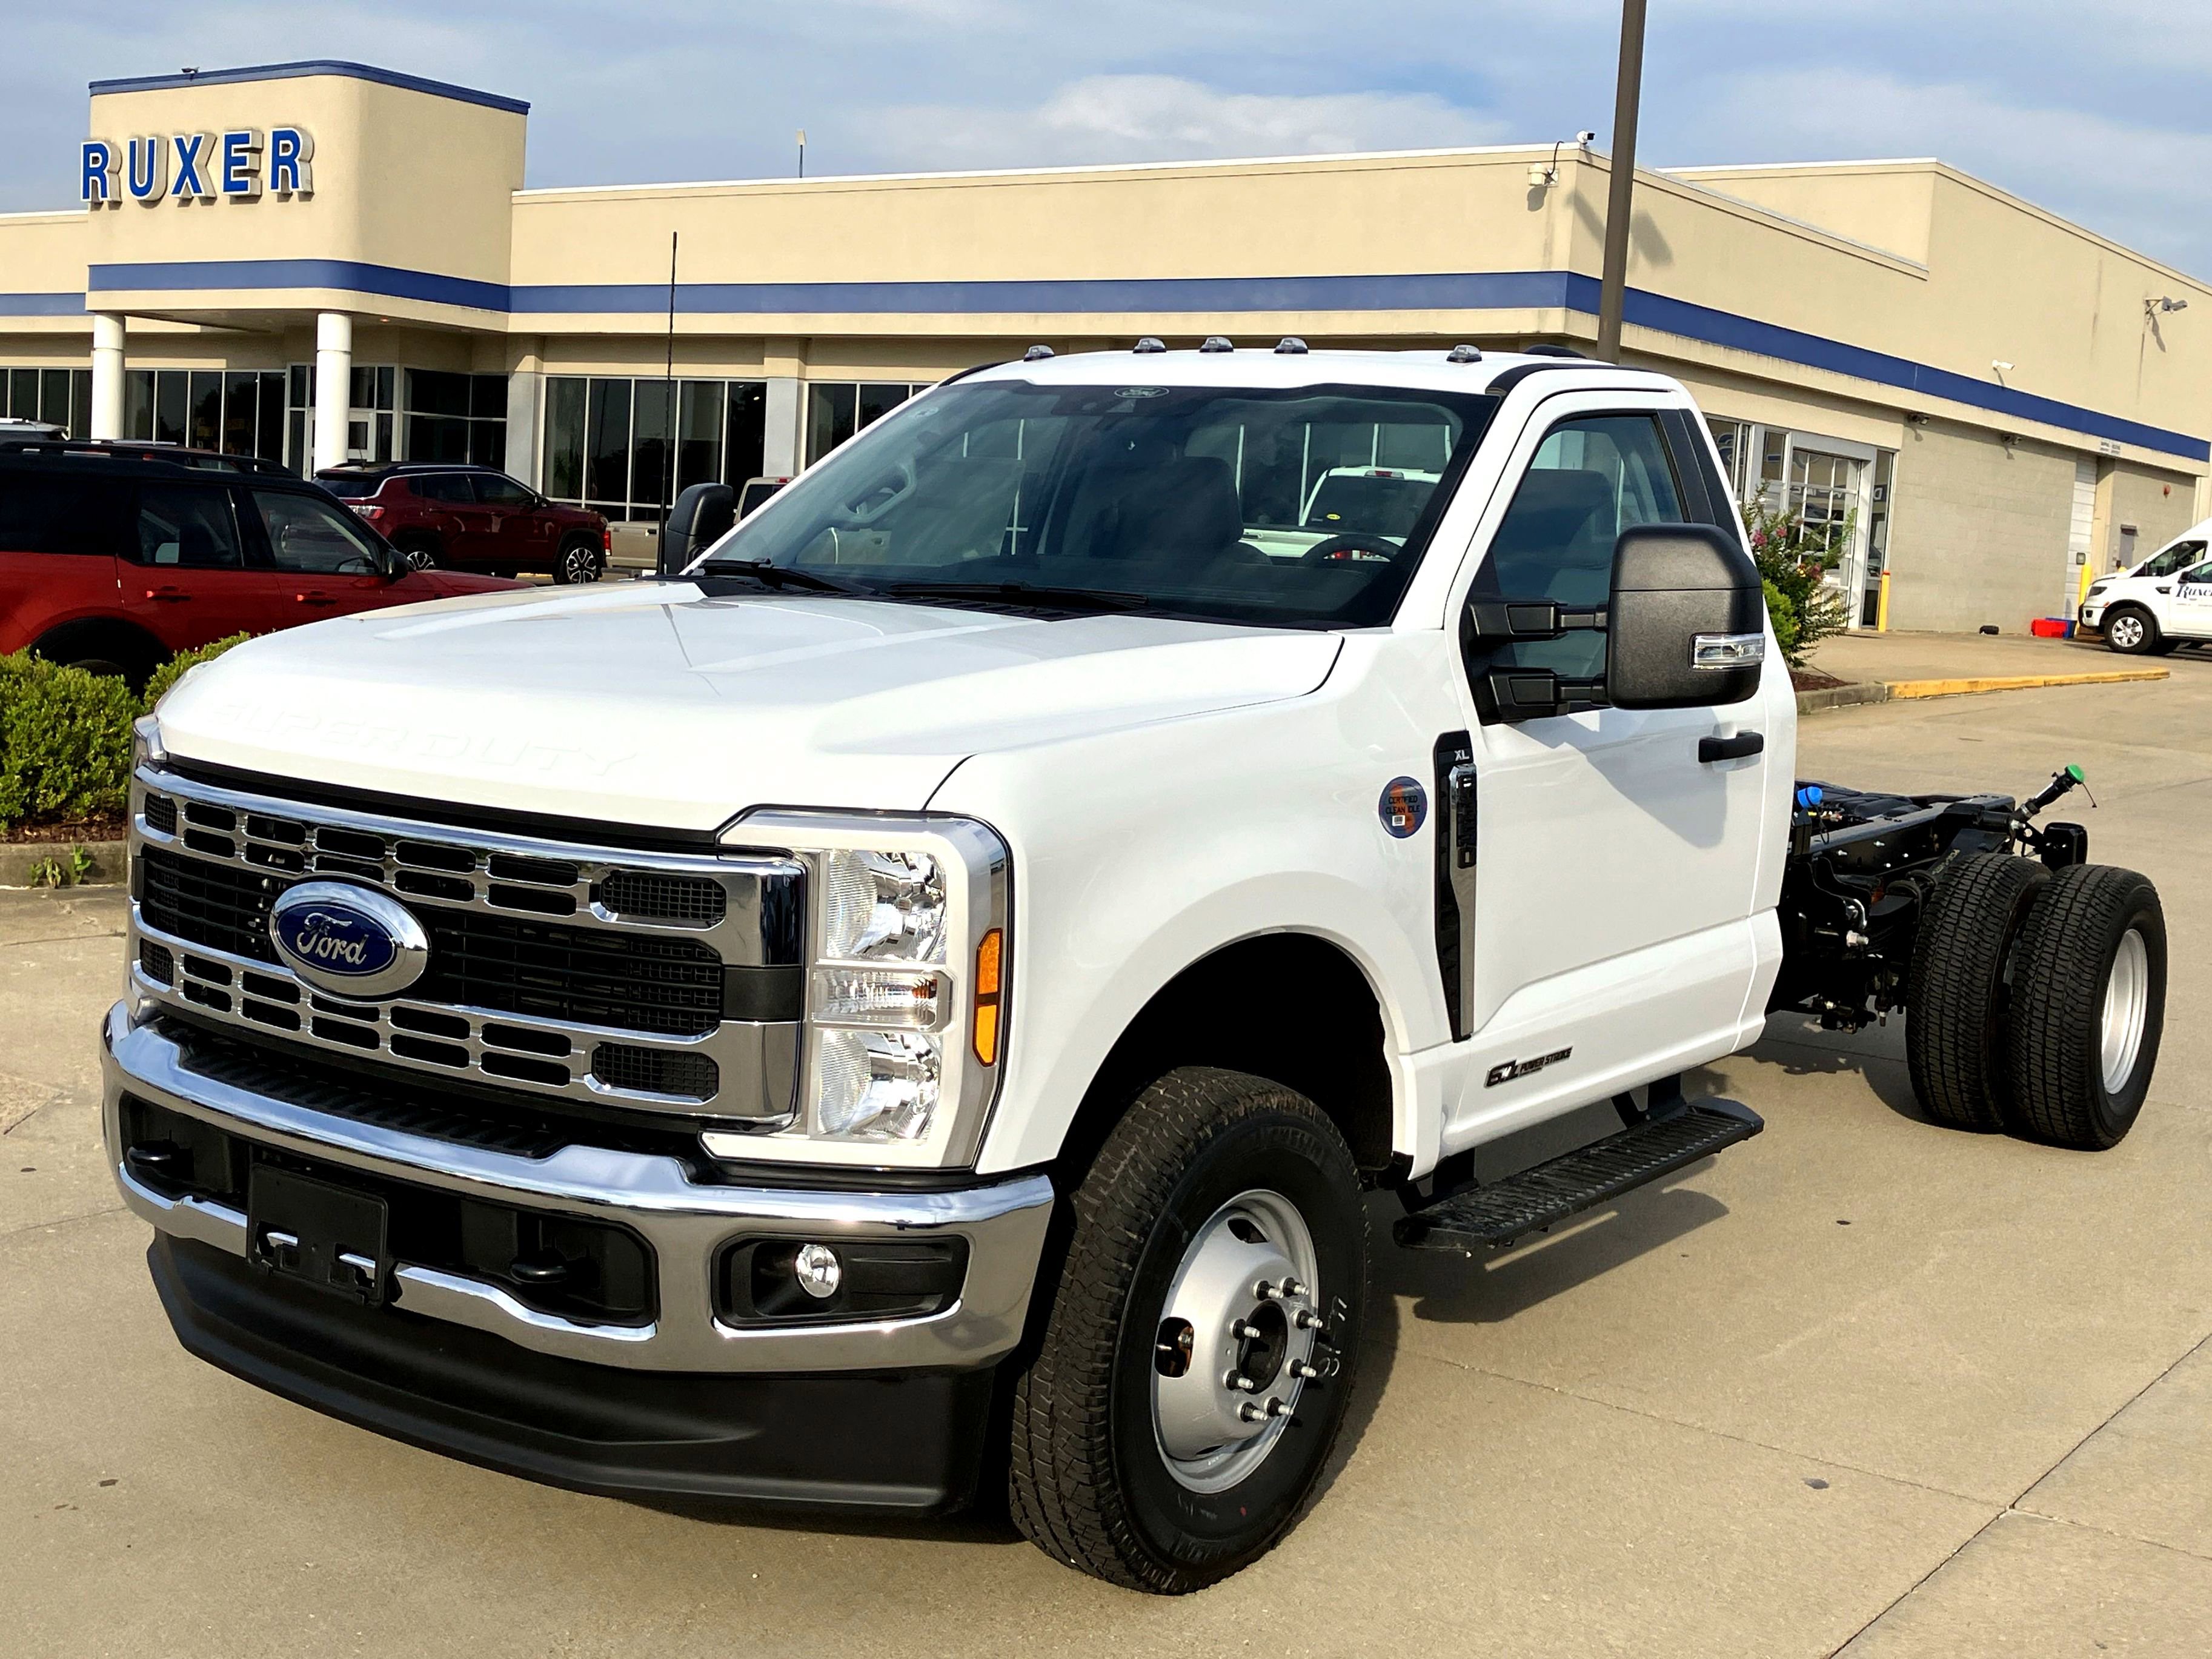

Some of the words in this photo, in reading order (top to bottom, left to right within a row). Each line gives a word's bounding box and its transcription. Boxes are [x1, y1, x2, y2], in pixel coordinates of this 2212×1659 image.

[81, 126, 313, 202] RUXER
[210, 702, 410, 753] SUPER
[418, 731, 638, 777] DUTY
[1454, 749, 1470, 761] XL
[1386, 805, 1406, 815] CLEAN
[1388, 795, 1418, 804] CERTIFIED
[296, 912, 369, 965] Ford
